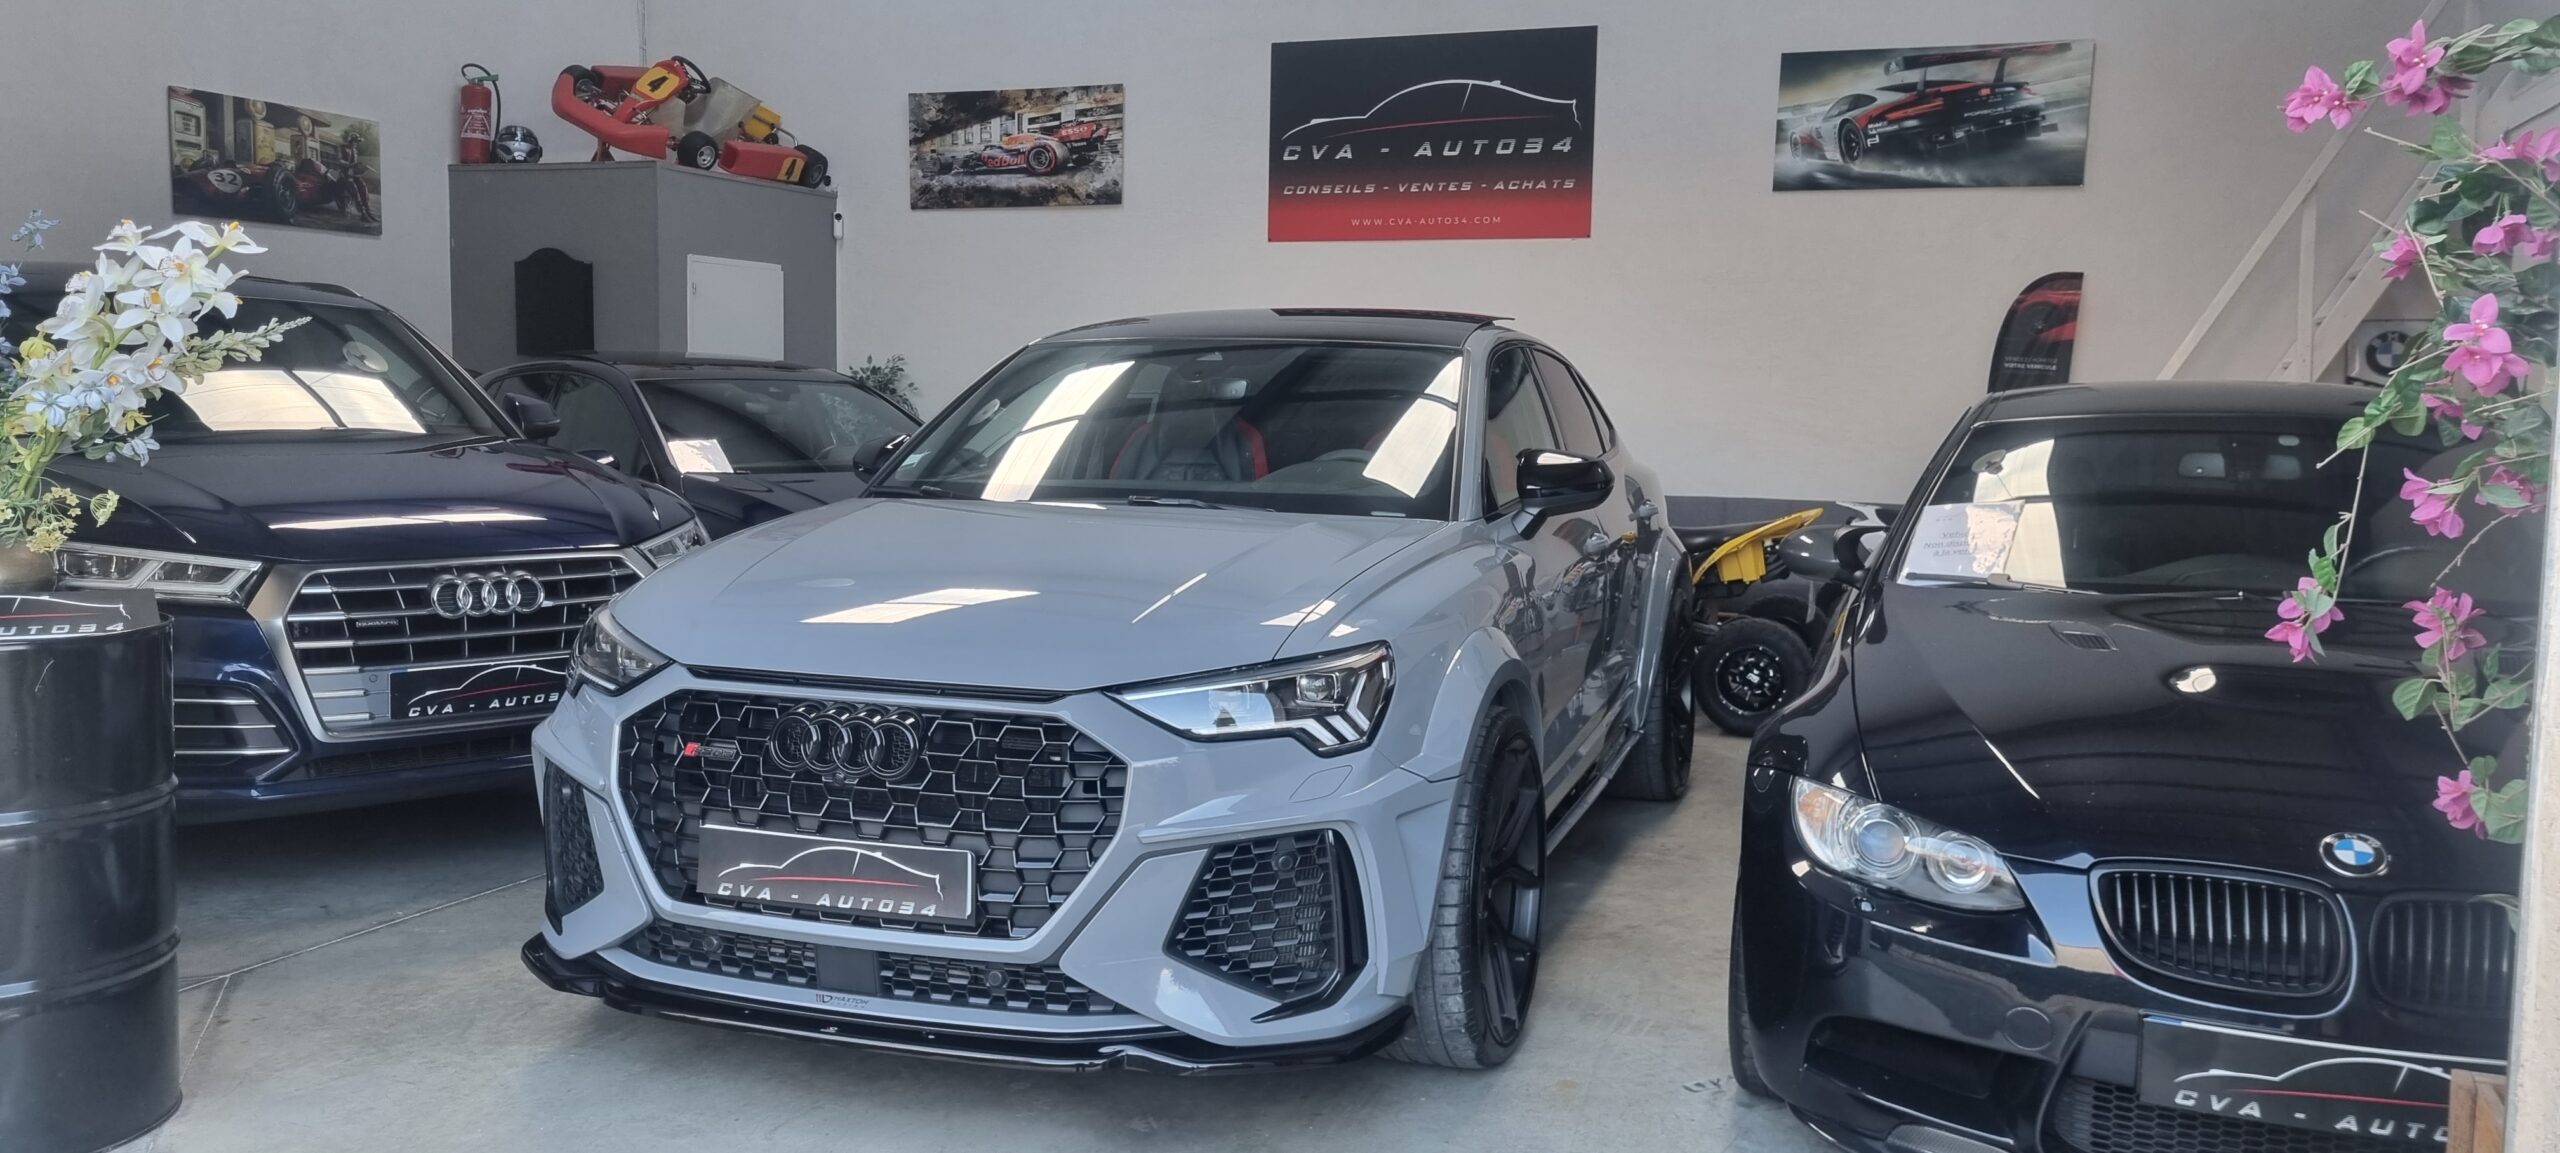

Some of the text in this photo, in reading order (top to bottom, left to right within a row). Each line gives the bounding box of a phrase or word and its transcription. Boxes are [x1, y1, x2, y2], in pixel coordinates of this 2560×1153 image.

[647, 75, 669, 93] 4
[1061, 125, 1088, 136] ESSO
[1282, 144, 1353, 161] CVA
[1413, 136, 1573, 158] AUTO34
[783, 158, 798, 180] 4
[213, 170, 240, 187] 32
[1283, 183, 1376, 195] CONSEILS
[1398, 181, 1473, 193] VENTES
[1493, 178, 1577, 191] ACHATS
[1351, 216, 1502, 227] WWW.CVA-AUTO34.COM
[0, 622, 124, 636] UTO34
[408, 703, 453, 718] CVA
[489, 692, 560, 709] AUTO3
[717, 882, 771, 901] CVA
[816, 893, 937, 917] AUTO34
[2174, 1089, 2262, 1119] CVA
[2334, 1114, 2449, 1142] AUTO
